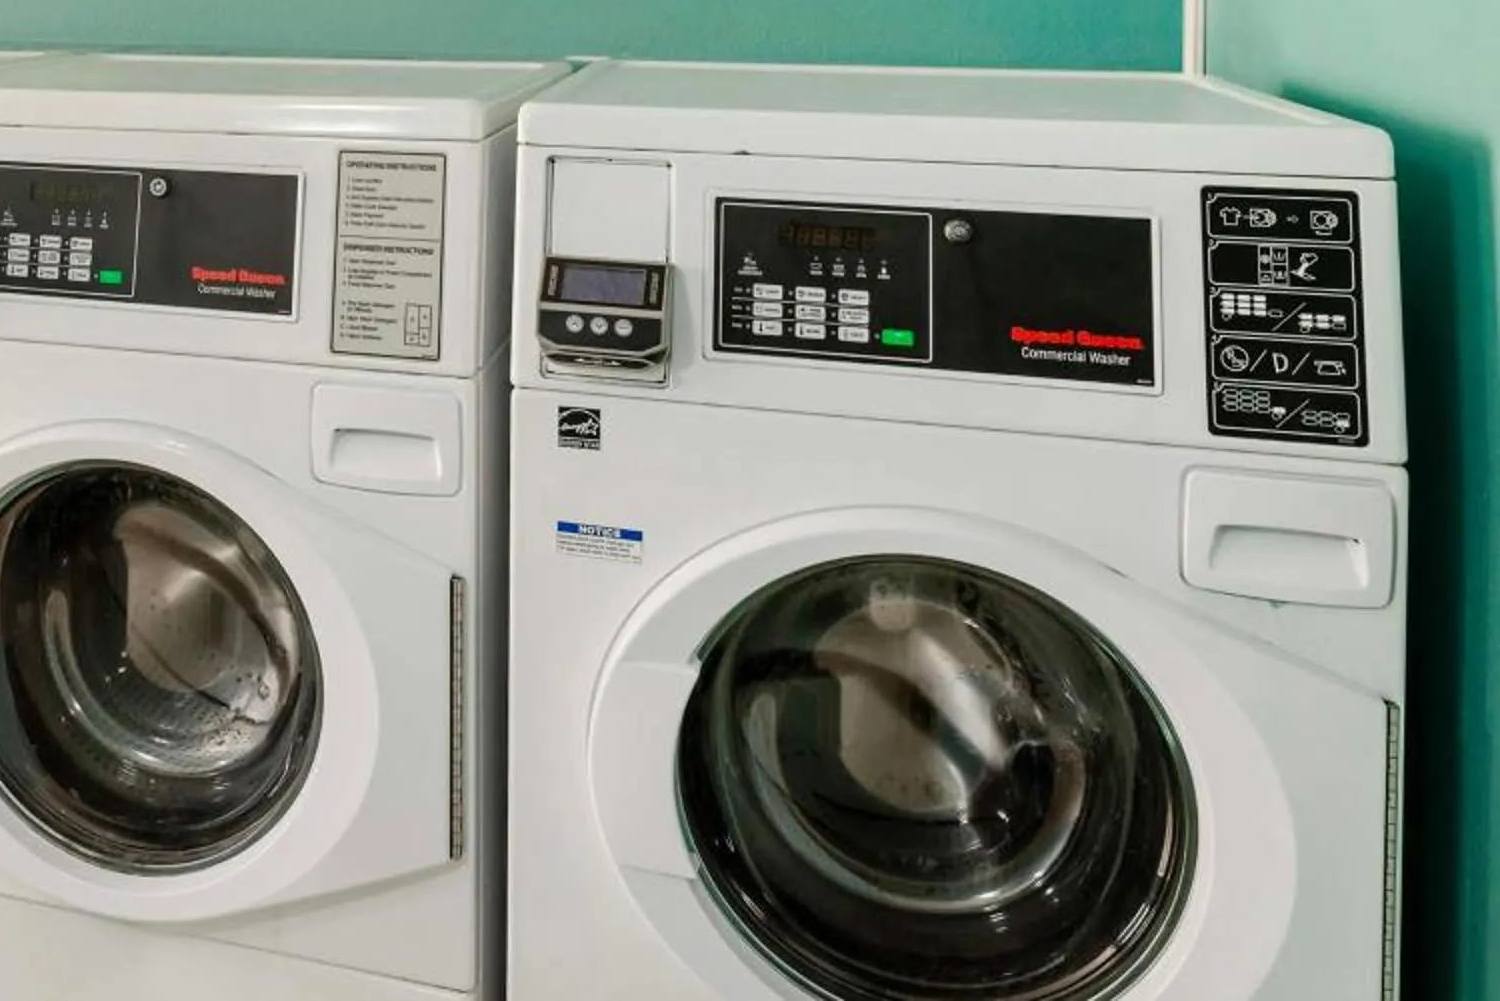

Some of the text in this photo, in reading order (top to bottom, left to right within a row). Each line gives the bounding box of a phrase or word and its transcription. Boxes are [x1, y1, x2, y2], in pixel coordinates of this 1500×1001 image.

[192, 266, 285, 284] Speed Queen
[197, 282, 277, 299] Commercial Washer
[1011, 326, 1143, 349] Speed Queen
[1021, 346, 1132, 366] Commercial Washer
[578, 524, 621, 538] NOTICE
